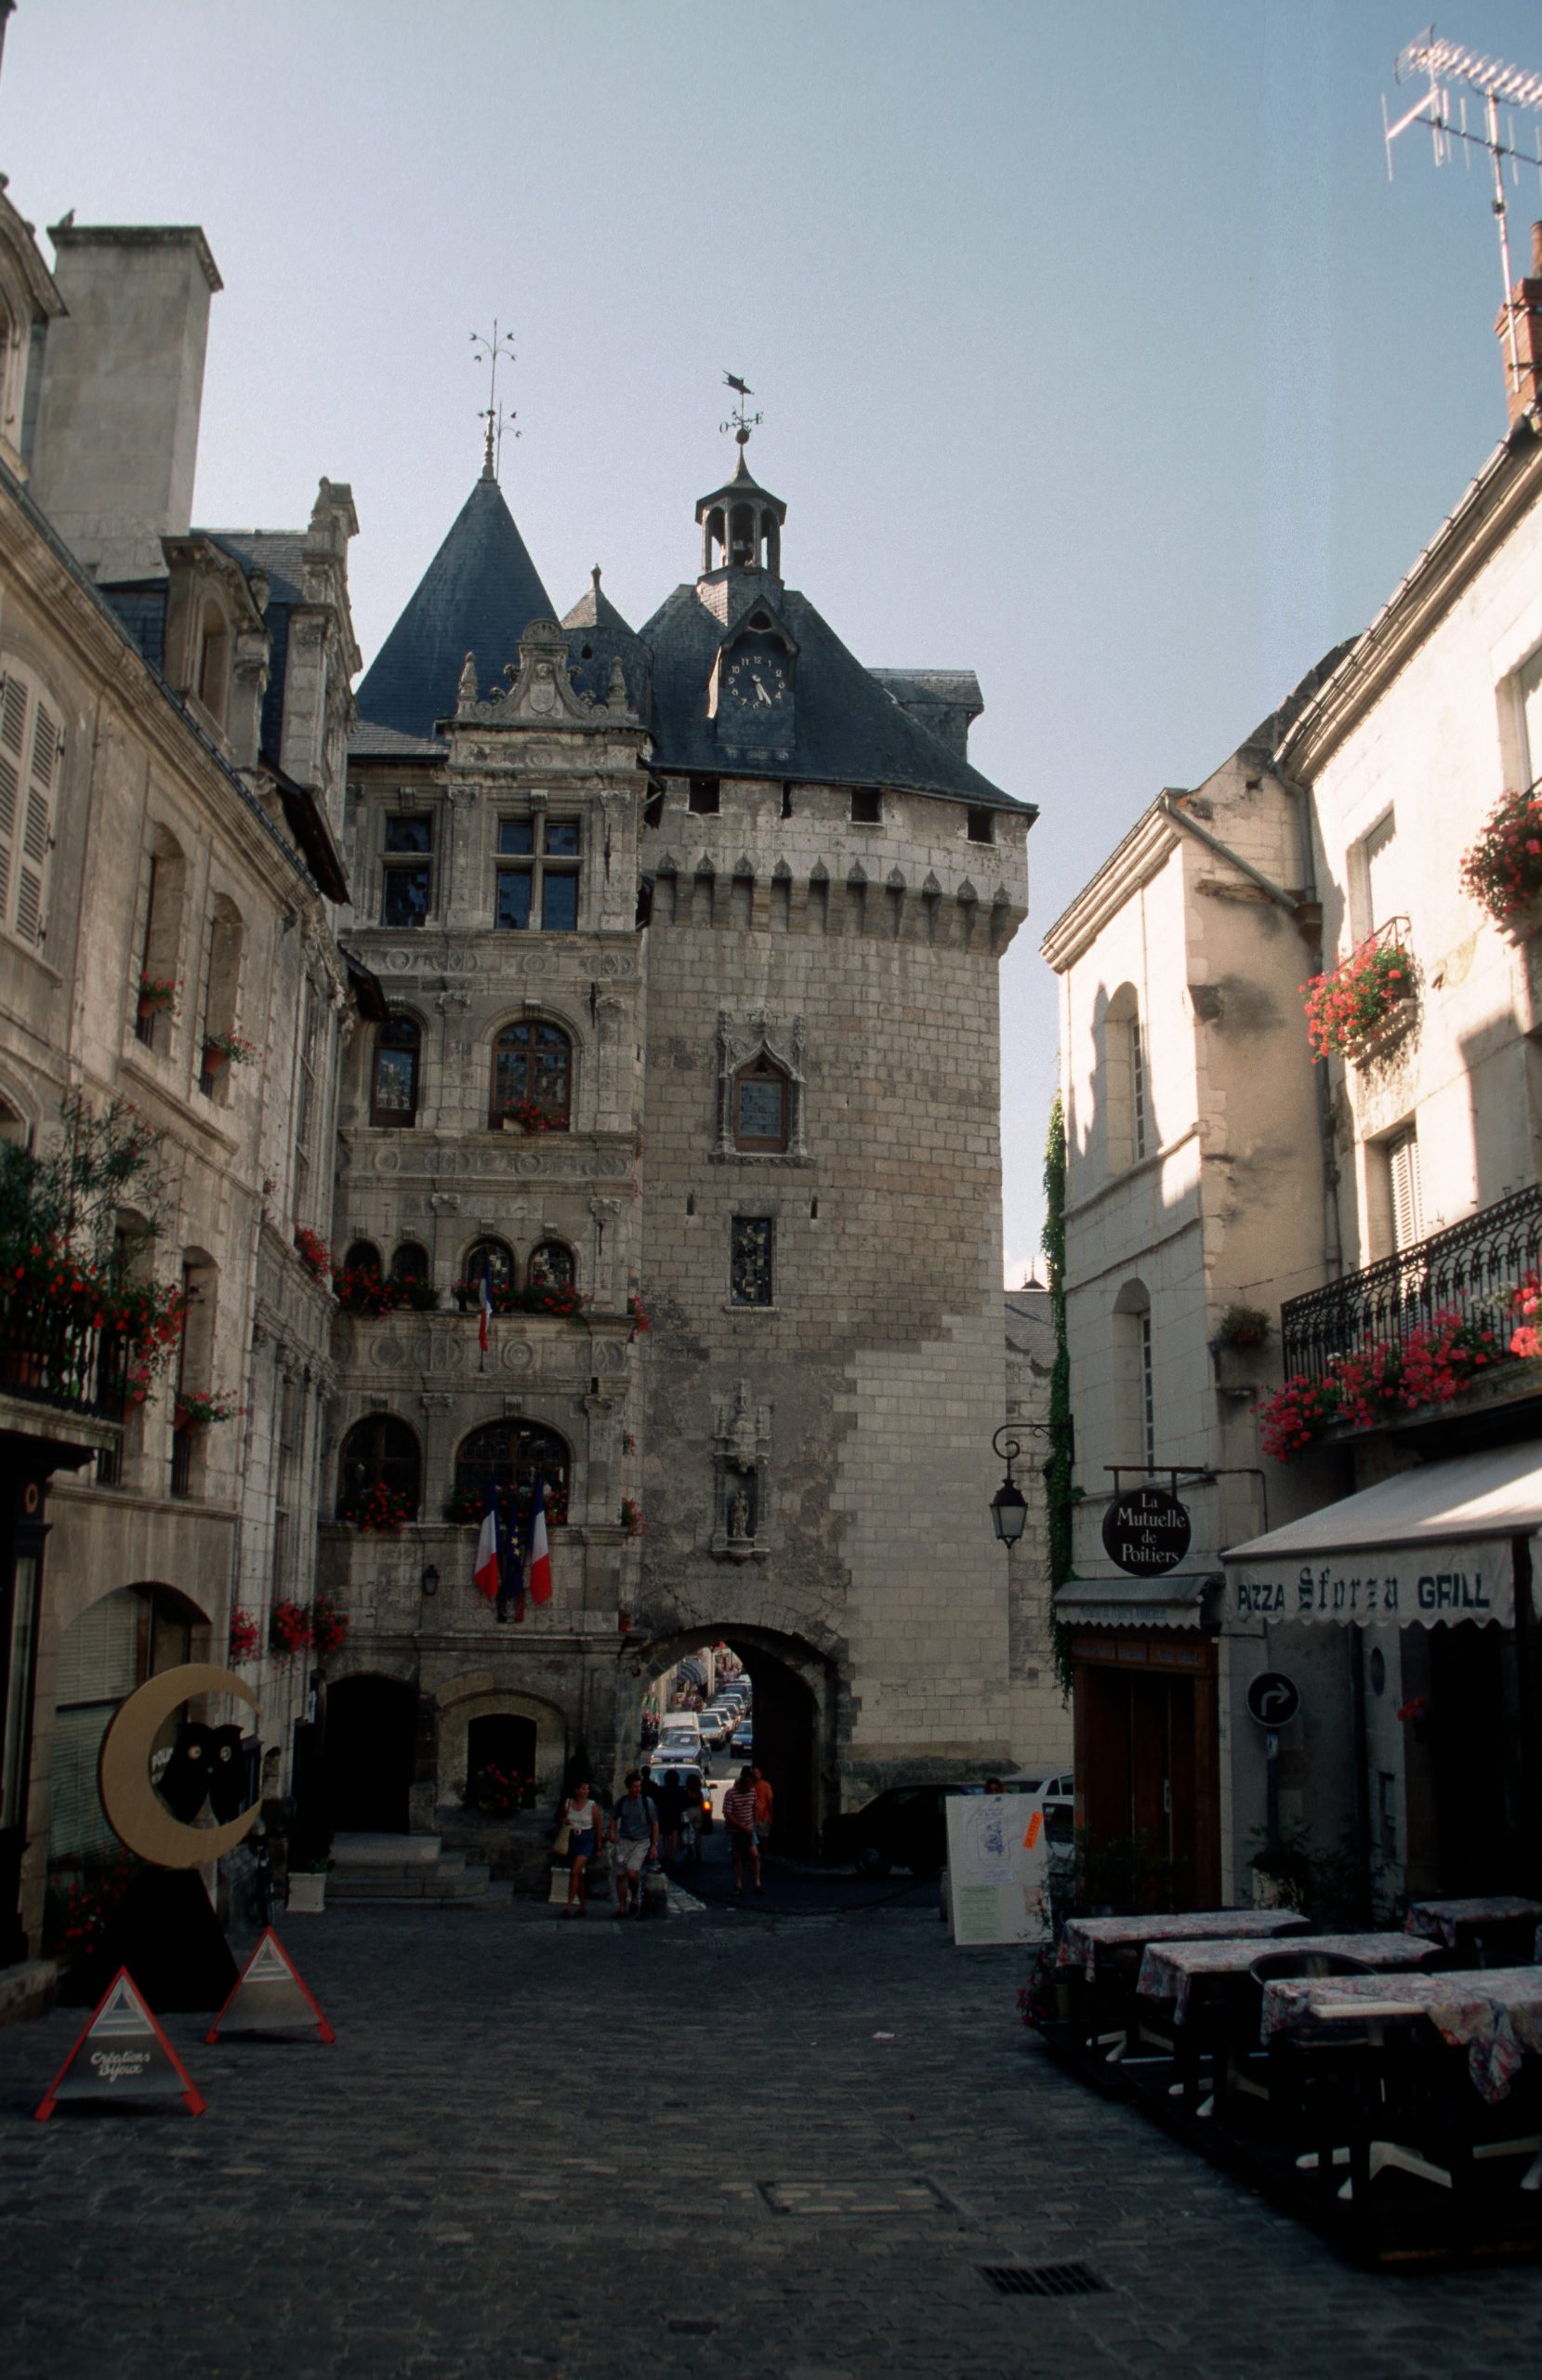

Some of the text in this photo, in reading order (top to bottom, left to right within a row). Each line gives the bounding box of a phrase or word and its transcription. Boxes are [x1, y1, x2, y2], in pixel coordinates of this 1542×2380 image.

[741, 657, 749, 666] 11
[753, 655, 762, 665] 12
[768, 659, 772, 668] 1
[731, 665, 740, 674] 10
[775, 668, 783, 678] 2
[728, 676, 735, 685] 9
[774, 691, 782, 699] 4
[740, 697, 747, 706] 7
[752, 701, 759, 709] 6
[1141, 1492, 1158, 1508] La
[1116, 1507, 1187, 1527] Mutuelle
[1140, 1529, 1157, 1544] de
[1122, 1543, 1180, 1563] Poitiers
[1237, 1567, 1490, 1611] PIZZA Sforza GRILL
